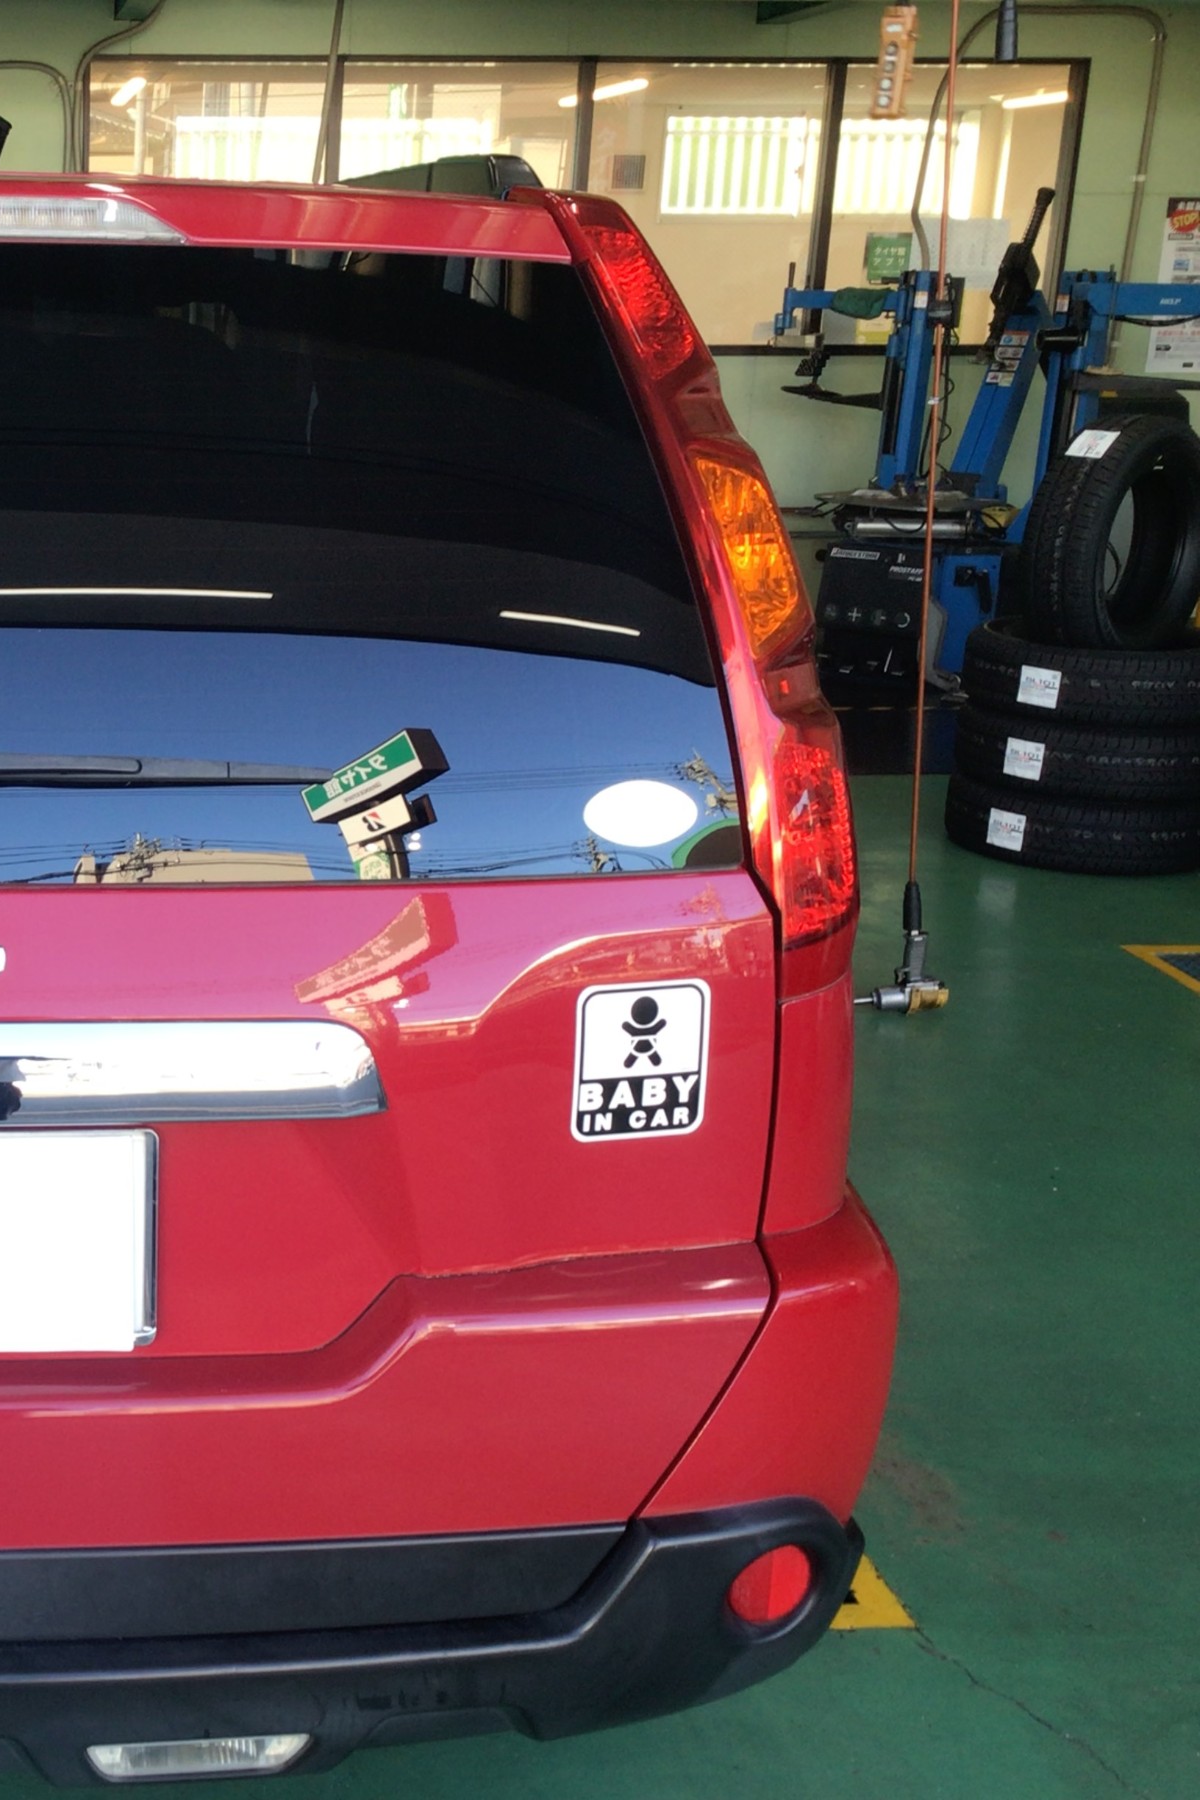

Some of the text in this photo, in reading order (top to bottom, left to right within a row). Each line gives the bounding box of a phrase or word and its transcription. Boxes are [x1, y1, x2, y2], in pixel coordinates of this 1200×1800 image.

[889, 566, 925, 575] PROSTAFF
[578, 1074, 699, 1112] BABY
[582, 1106, 690, 1133] IN CAR
